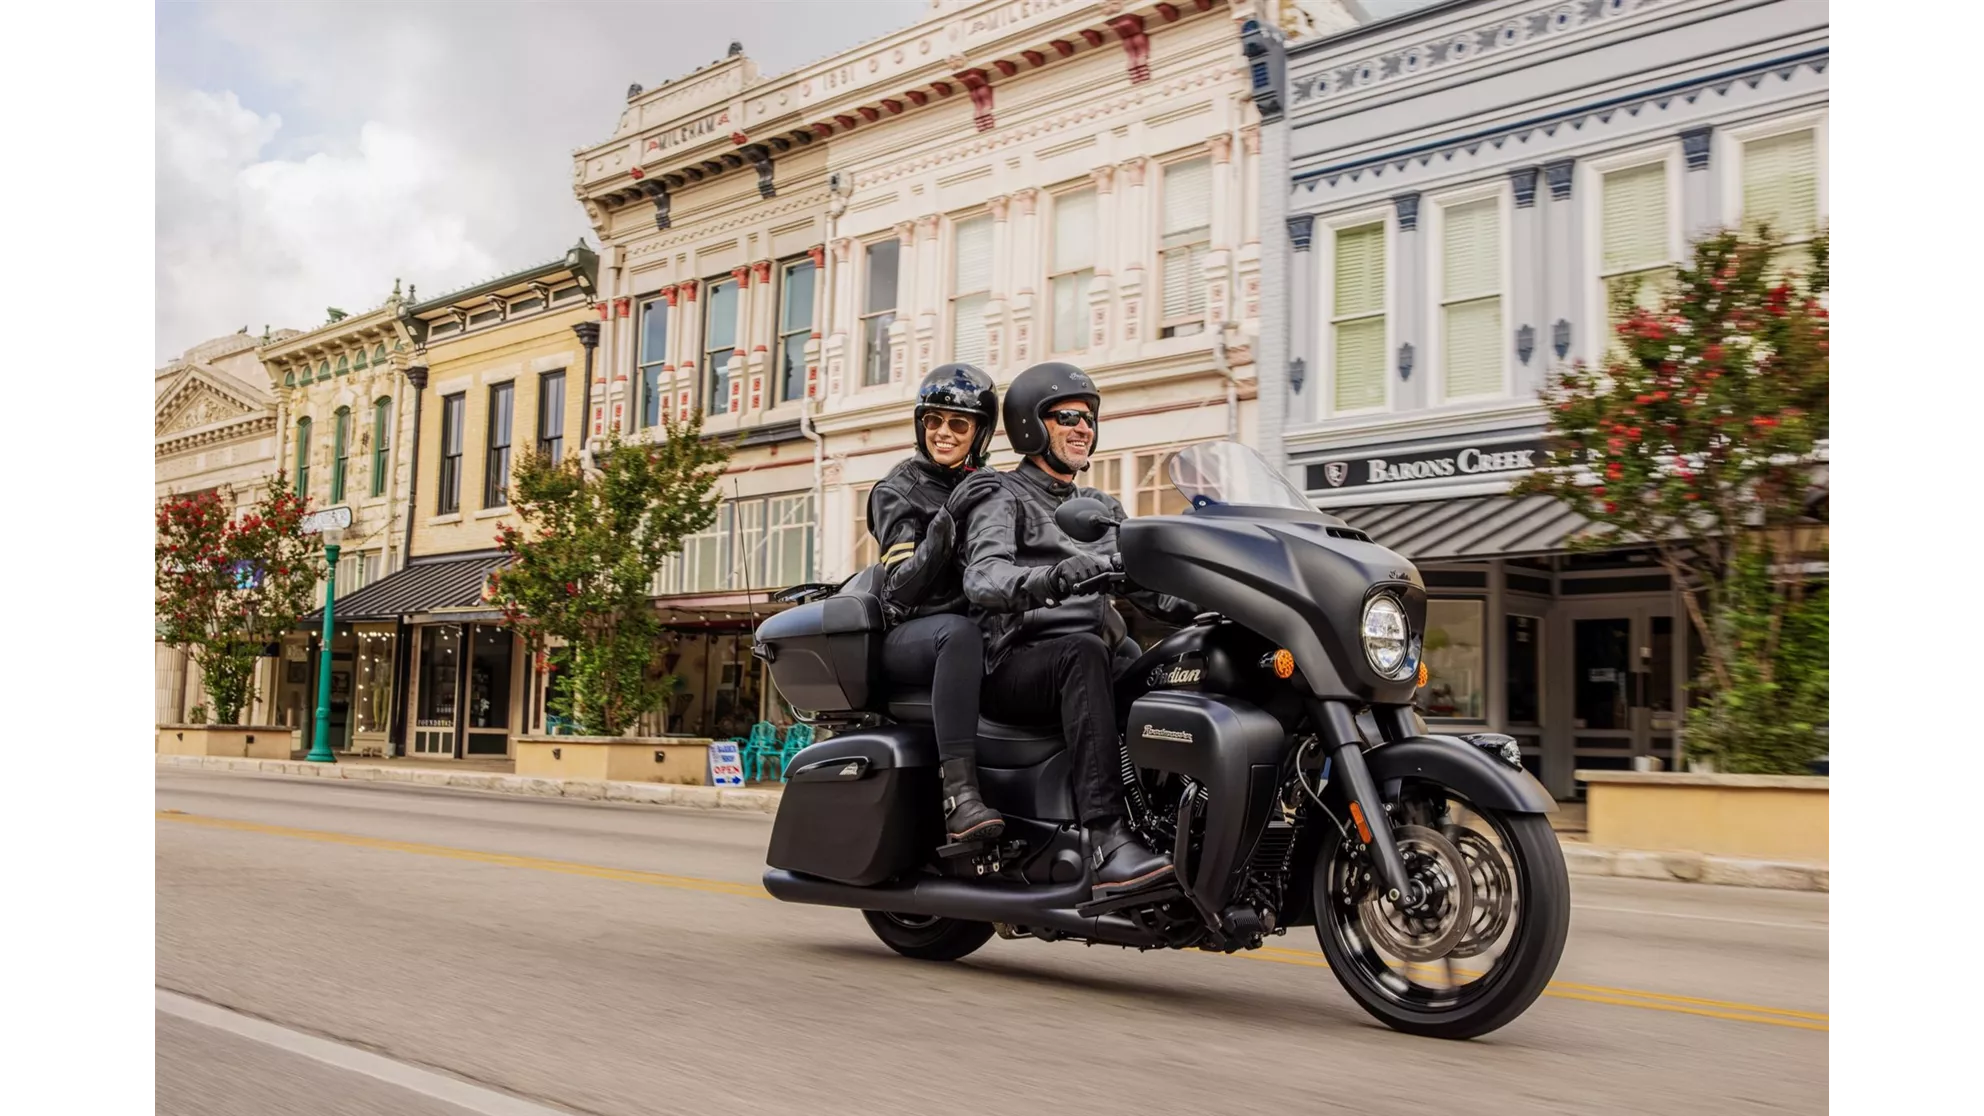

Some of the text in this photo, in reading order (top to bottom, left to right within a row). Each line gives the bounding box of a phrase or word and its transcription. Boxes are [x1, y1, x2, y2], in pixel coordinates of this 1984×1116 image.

[986, 0, 1073, 31] MILEH
[659, 115, 715, 150] MILEHAM
[1146, 663, 1201, 687] Indian
[713, 765, 740, 775] OPEN
